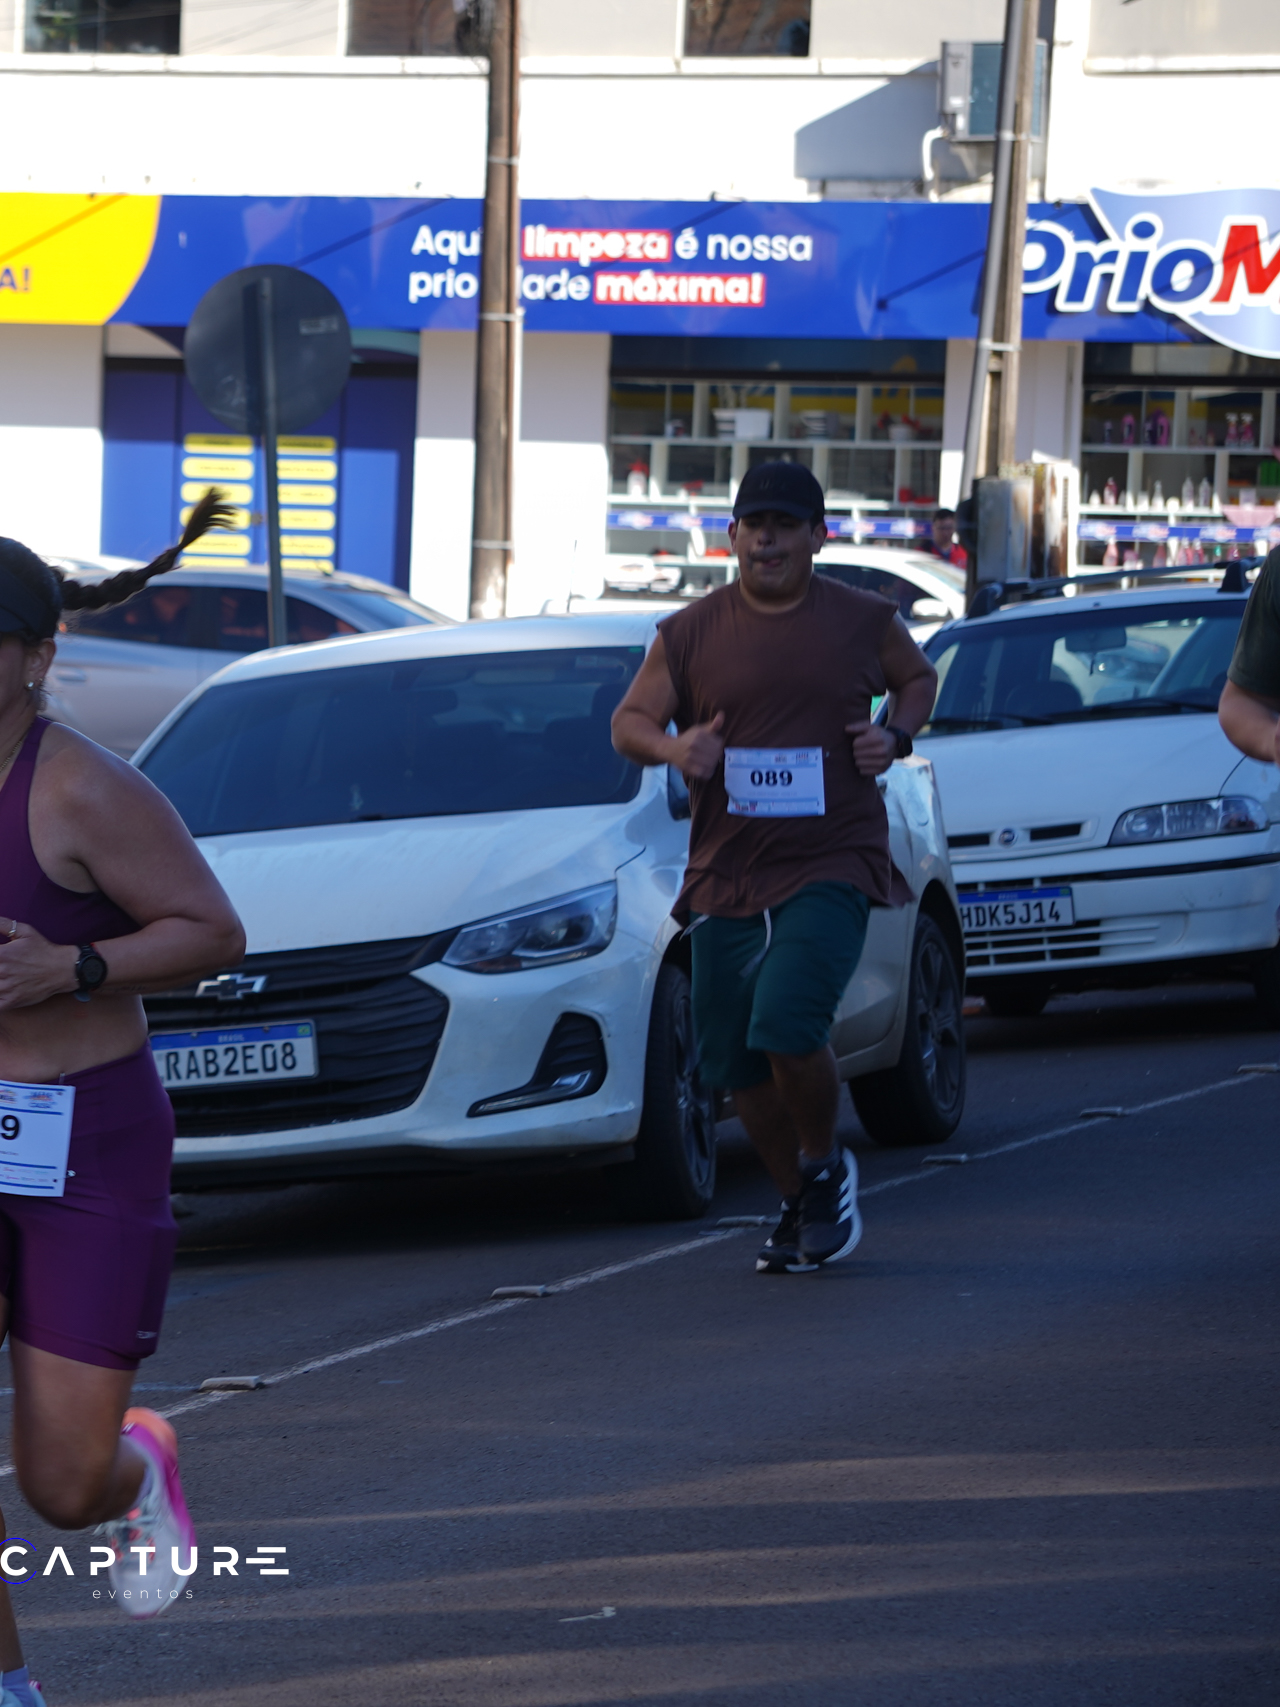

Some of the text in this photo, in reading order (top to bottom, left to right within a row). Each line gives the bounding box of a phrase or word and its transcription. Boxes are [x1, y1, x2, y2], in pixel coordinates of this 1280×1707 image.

[411, 223, 812, 267] Aqu limpeza é nossa
[595, 268, 763, 304] máxima!
[750, 769, 793, 787] 089
[960, 901, 1061, 928] HDK5J14
[165, 1041, 297, 1081] RAB2E08
